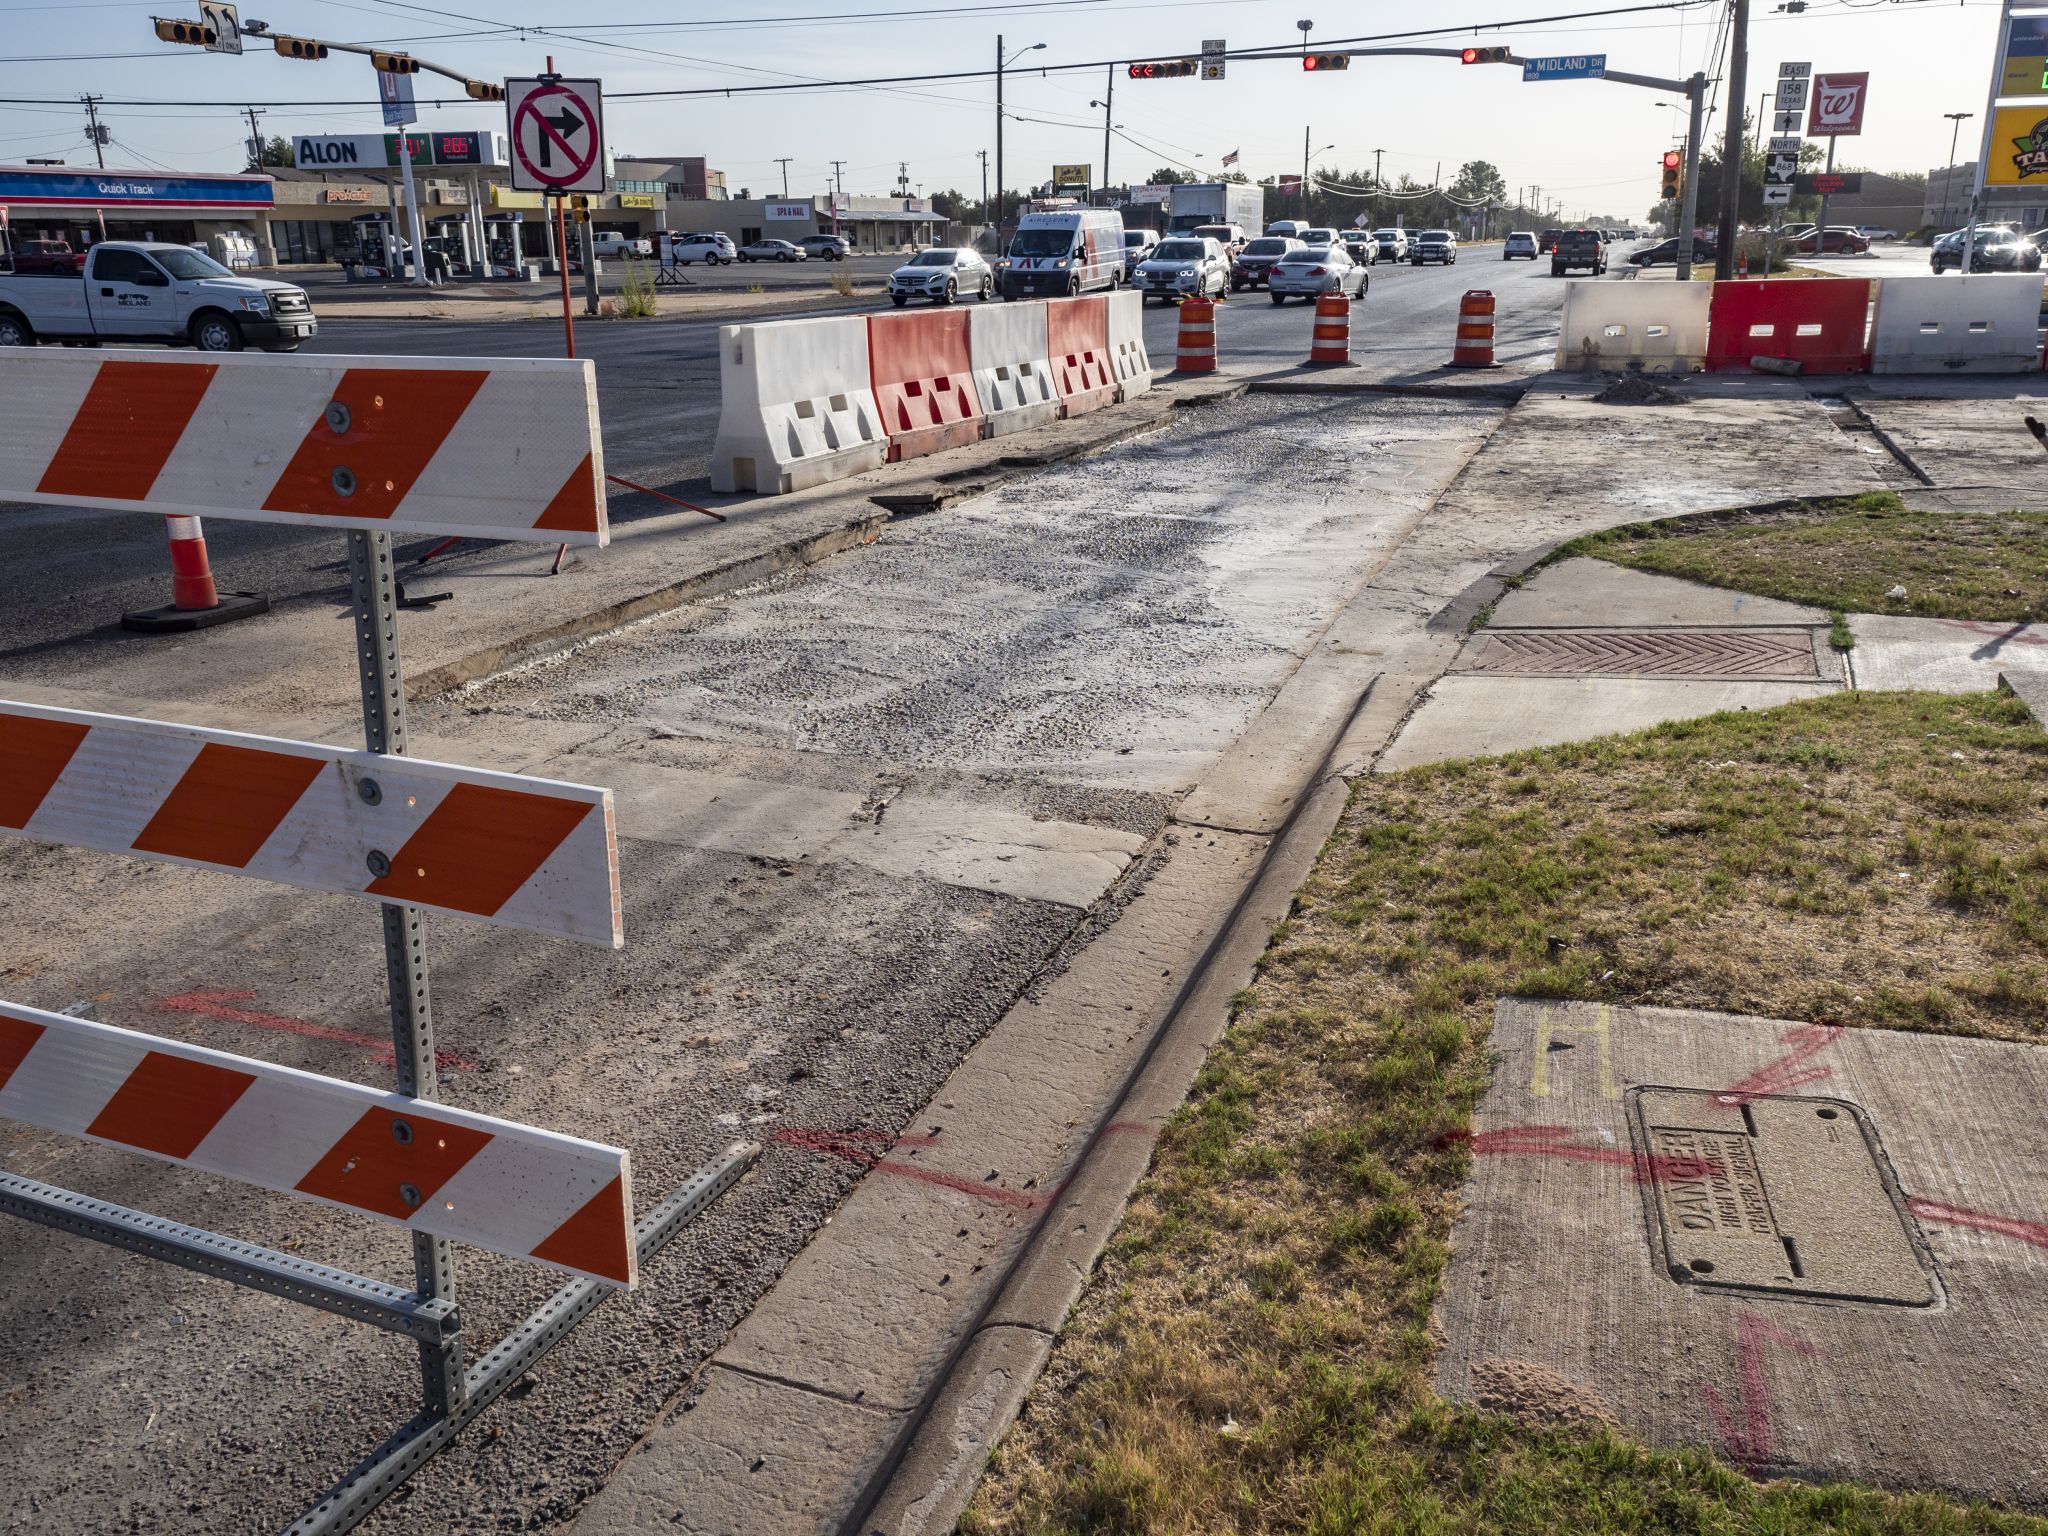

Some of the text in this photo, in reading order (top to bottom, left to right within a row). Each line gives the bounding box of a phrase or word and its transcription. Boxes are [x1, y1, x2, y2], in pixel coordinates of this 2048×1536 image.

[1526, 57, 1603, 71] N MIDLAND DR
[1784, 65, 1806, 75] EAST
[1525, 72, 1540, 80] 1800
[1783, 84, 1802, 94] 158
[1770, 140, 1799, 149] NORTH
[300, 139, 358, 164] ALON
[1776, 162, 1793, 170] 868
[98, 183, 155, 195] Quick Track
[1058, 189, 1087, 198] SUBWAY
[777, 207, 787, 217] SPA
[788, 207, 792, 217] &
[793, 207, 804, 217] NAIL
[1660, 1132, 1717, 1231] DANGER
[1700, 1139, 1743, 1229] HIGH VOLTAGE
[1725, 1137, 1771, 1234] TRAFFIC SIGNAL
